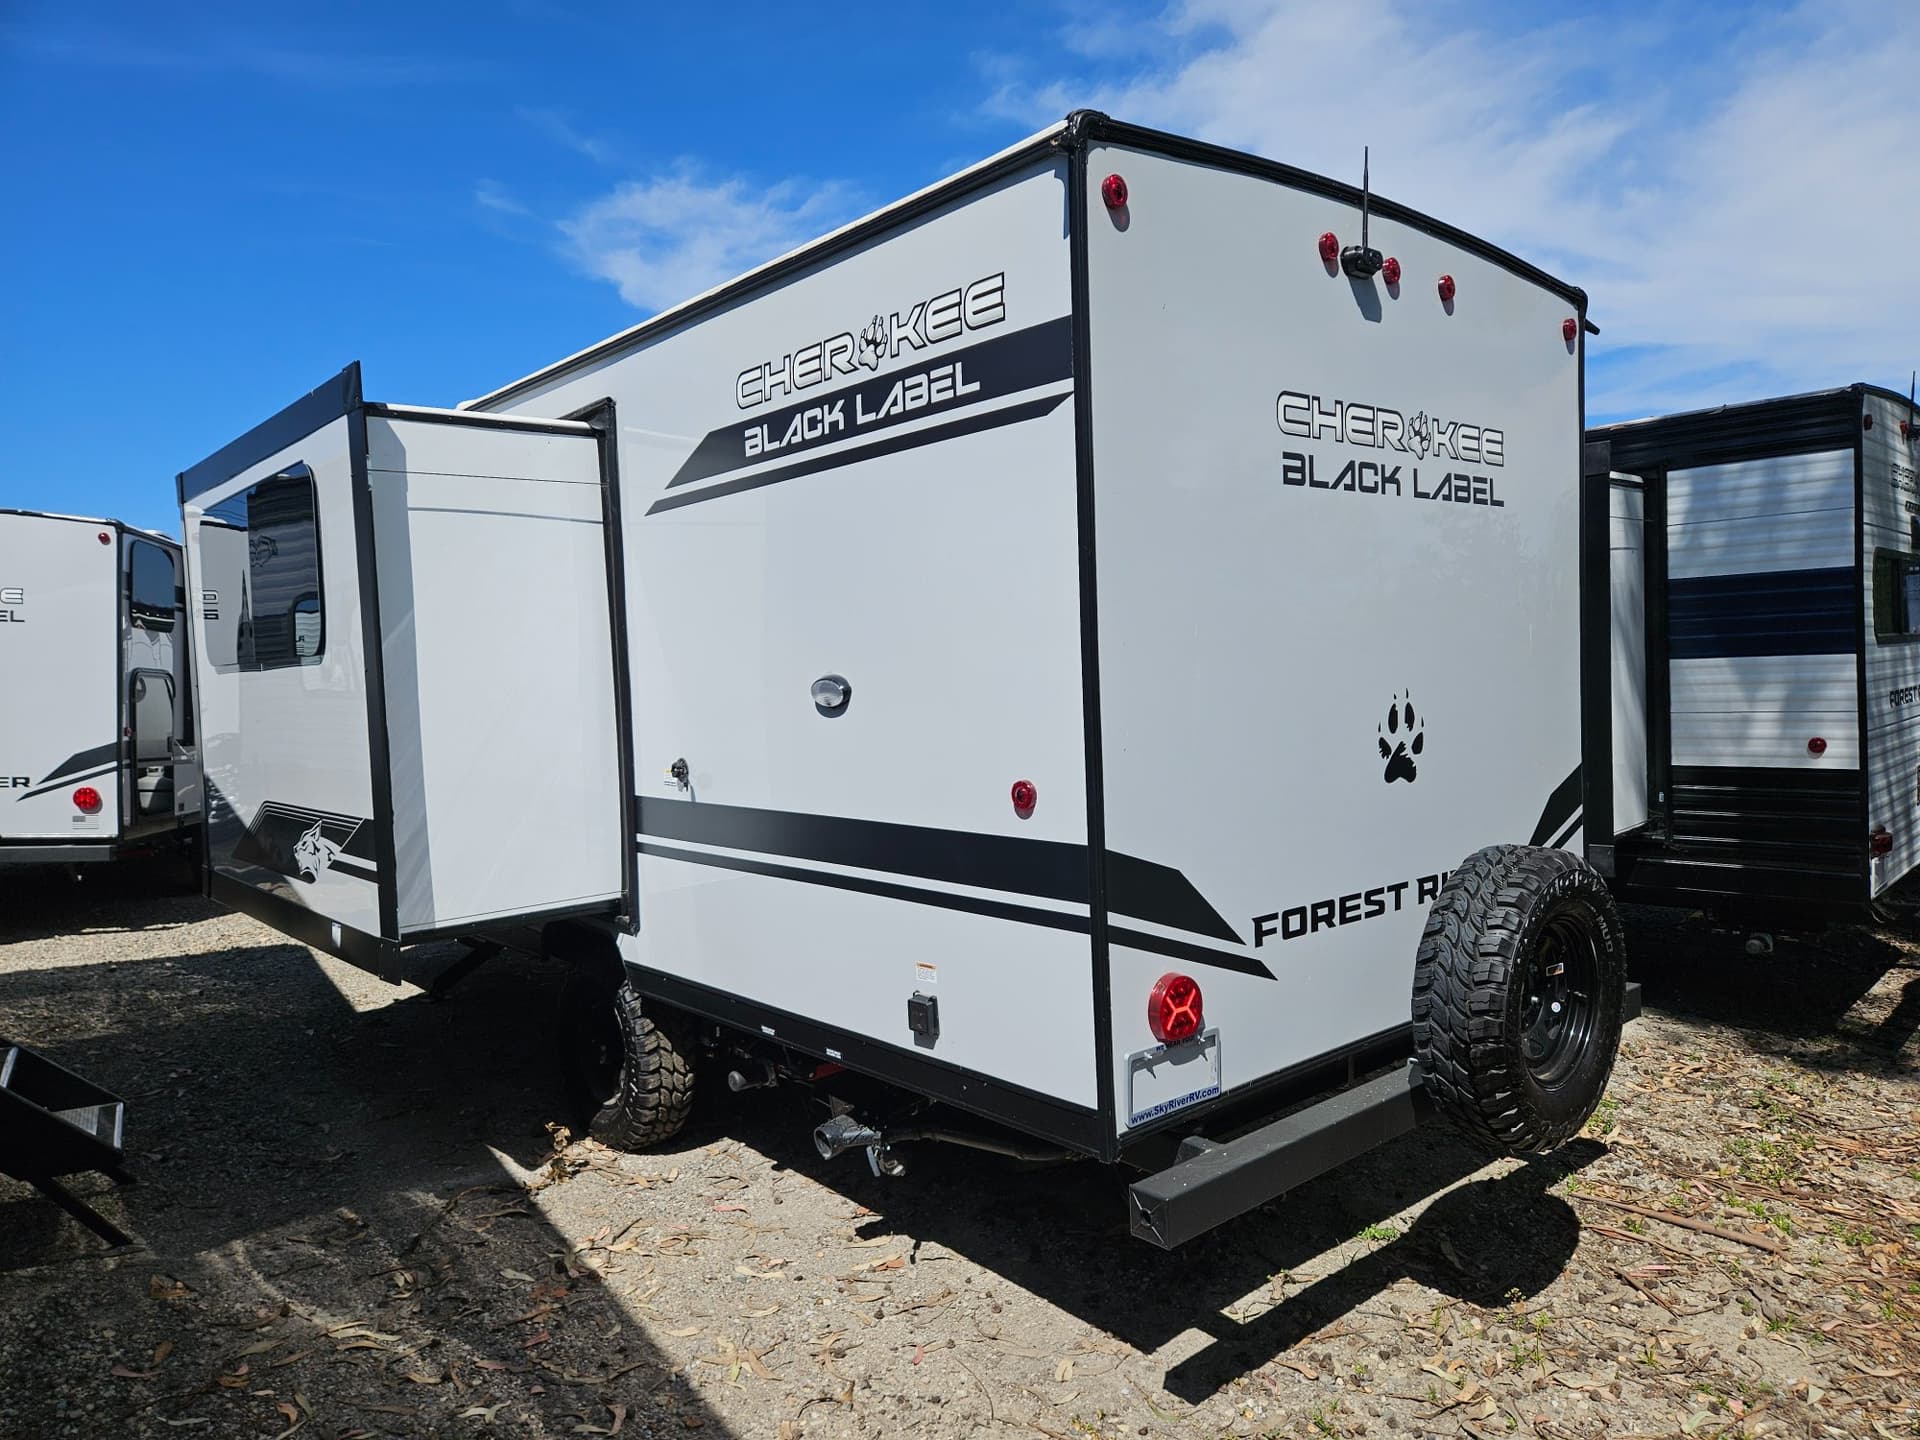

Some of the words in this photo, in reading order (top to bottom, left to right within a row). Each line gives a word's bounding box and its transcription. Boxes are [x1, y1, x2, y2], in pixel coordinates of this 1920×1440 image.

[744, 399, 845, 457] BLACK
[856, 361, 980, 424] LABEL
[1282, 451, 1402, 496] BLACK
[1413, 468, 1505, 507] LABEL
[1252, 881, 1409, 948] FOREST
[1131, 1086, 1219, 1125] www.SkyRiverRV.com
